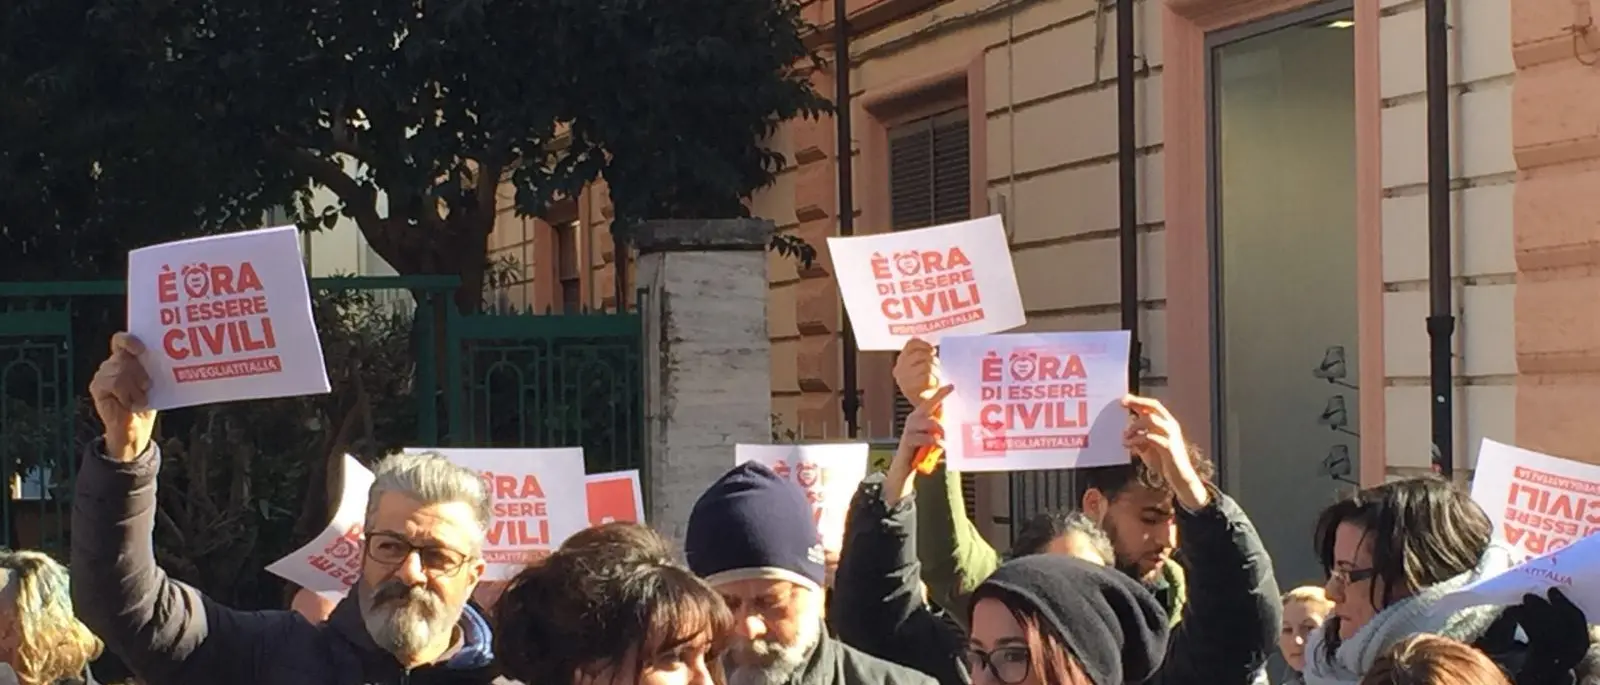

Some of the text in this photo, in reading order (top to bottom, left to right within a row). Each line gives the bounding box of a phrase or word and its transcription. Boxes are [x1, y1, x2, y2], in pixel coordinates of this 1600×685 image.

[870, 247, 971, 280] È ORA
[158, 261, 264, 303] È ORA
[876, 268, 976, 296] DI ESSERE
[160, 296, 269, 326] DI ESSERE
[880, 283, 981, 320] CIVILI
[163, 317, 277, 360] CIVILI
[981, 351, 1088, 382] È ORA
[981, 383, 1087, 400] DI ESSERE
[980, 401, 1089, 430] CIVILI
[494, 503, 547, 517] SERE
[1504, 507, 1578, 536] ESSERE
[486, 520, 549, 545] VILI
